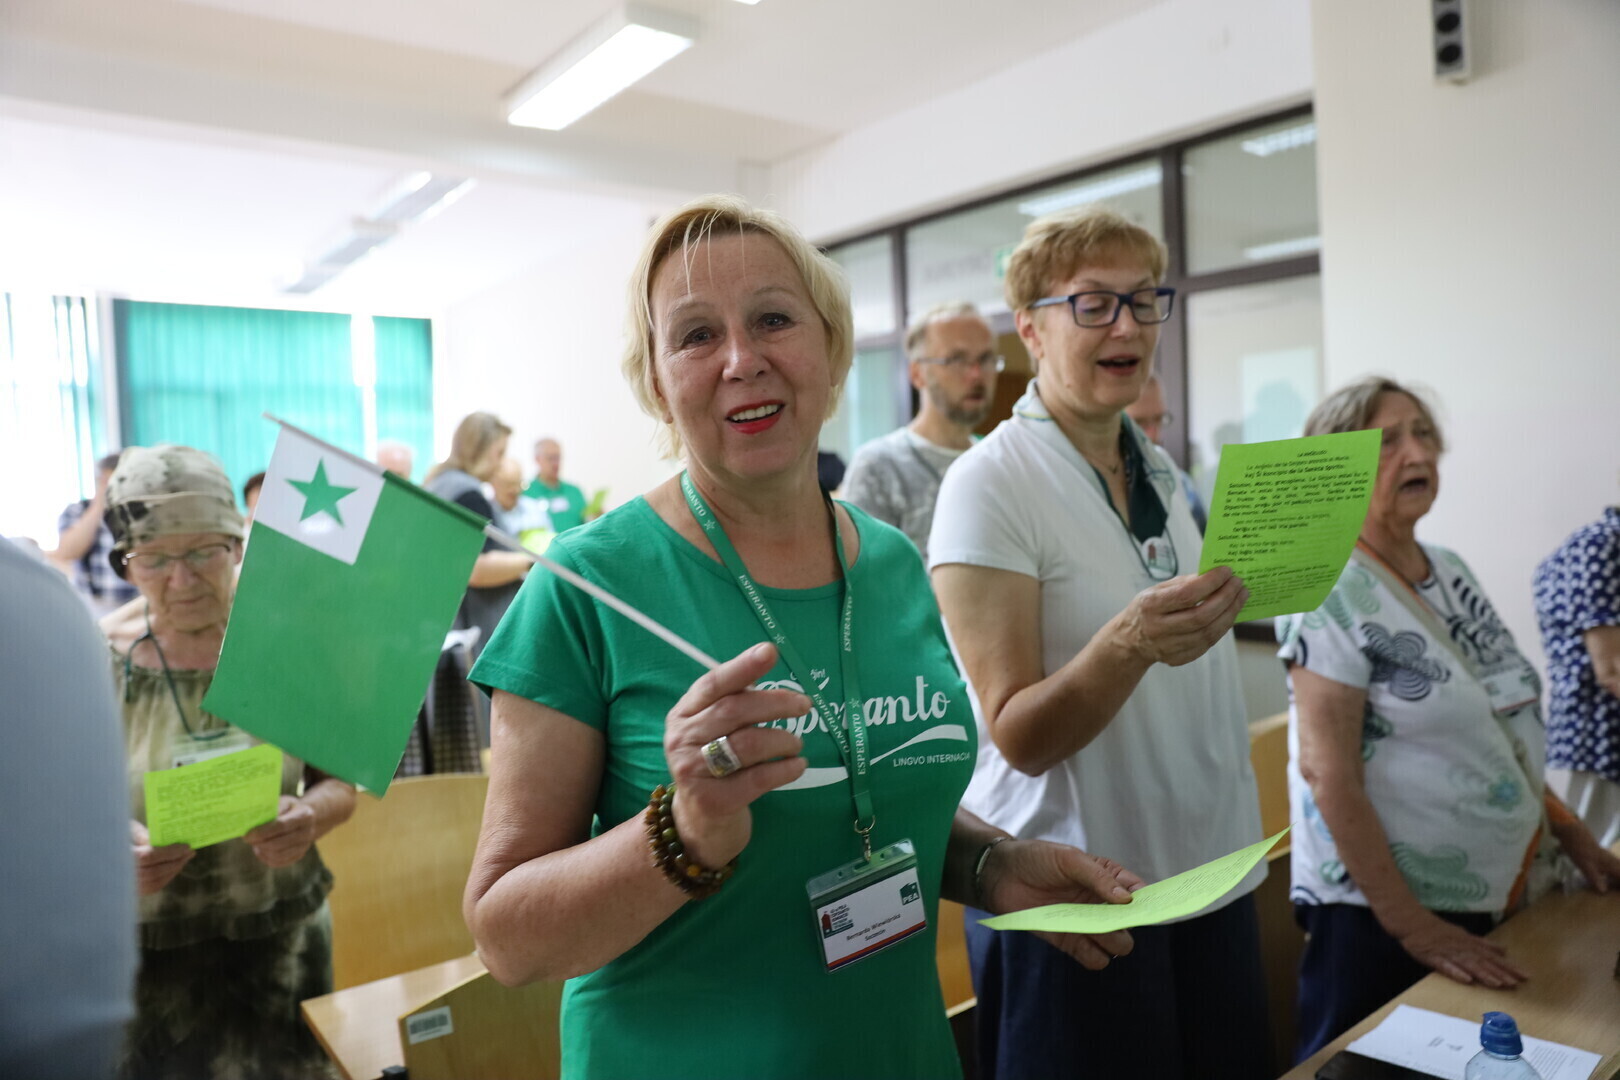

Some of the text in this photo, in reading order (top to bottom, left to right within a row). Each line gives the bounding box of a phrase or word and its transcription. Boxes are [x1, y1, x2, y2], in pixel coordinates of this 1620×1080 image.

[738, 574, 776, 629] ESPERANTO
[745, 675, 951, 738] panto
[813, 693, 851, 754] ESPERANTO
[853, 713, 866, 776] ESPERANTO
[893, 755, 926, 767] LINGVO
